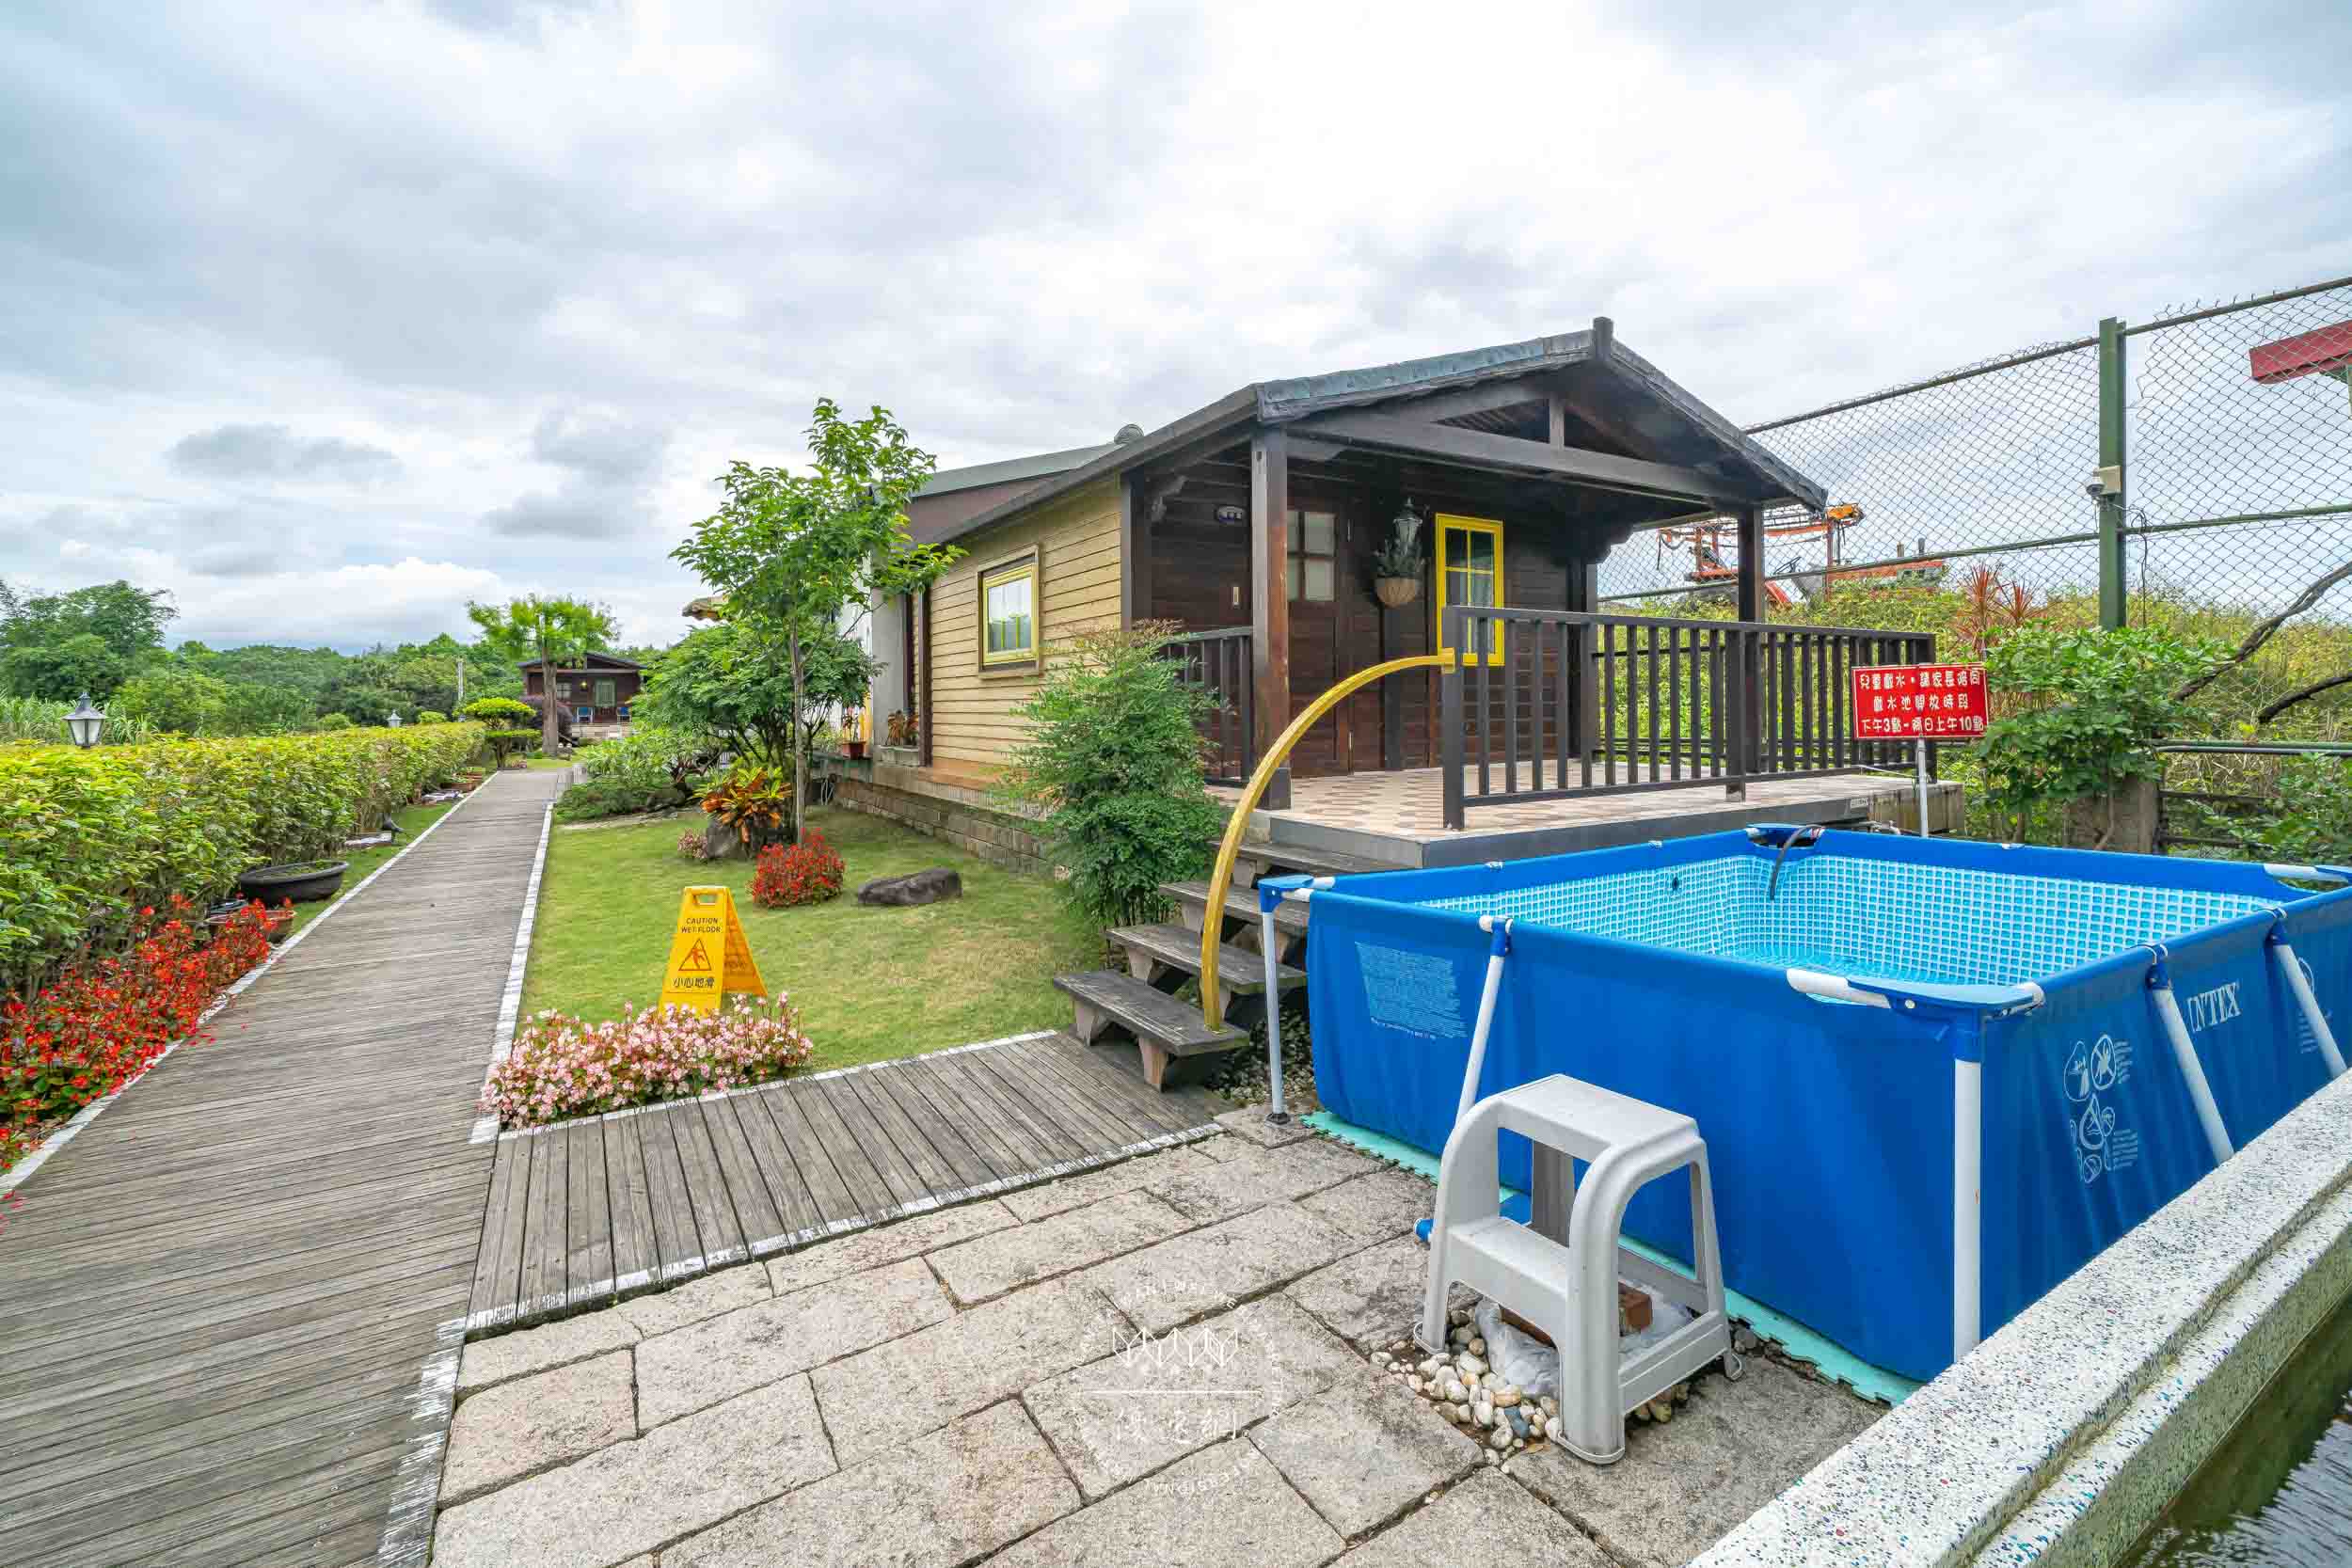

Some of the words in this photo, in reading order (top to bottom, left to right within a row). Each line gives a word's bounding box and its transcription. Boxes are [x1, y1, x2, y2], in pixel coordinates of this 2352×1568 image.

[673, 976, 715, 989] 小心地滑
[2186, 982, 2242, 1034] INTEX
